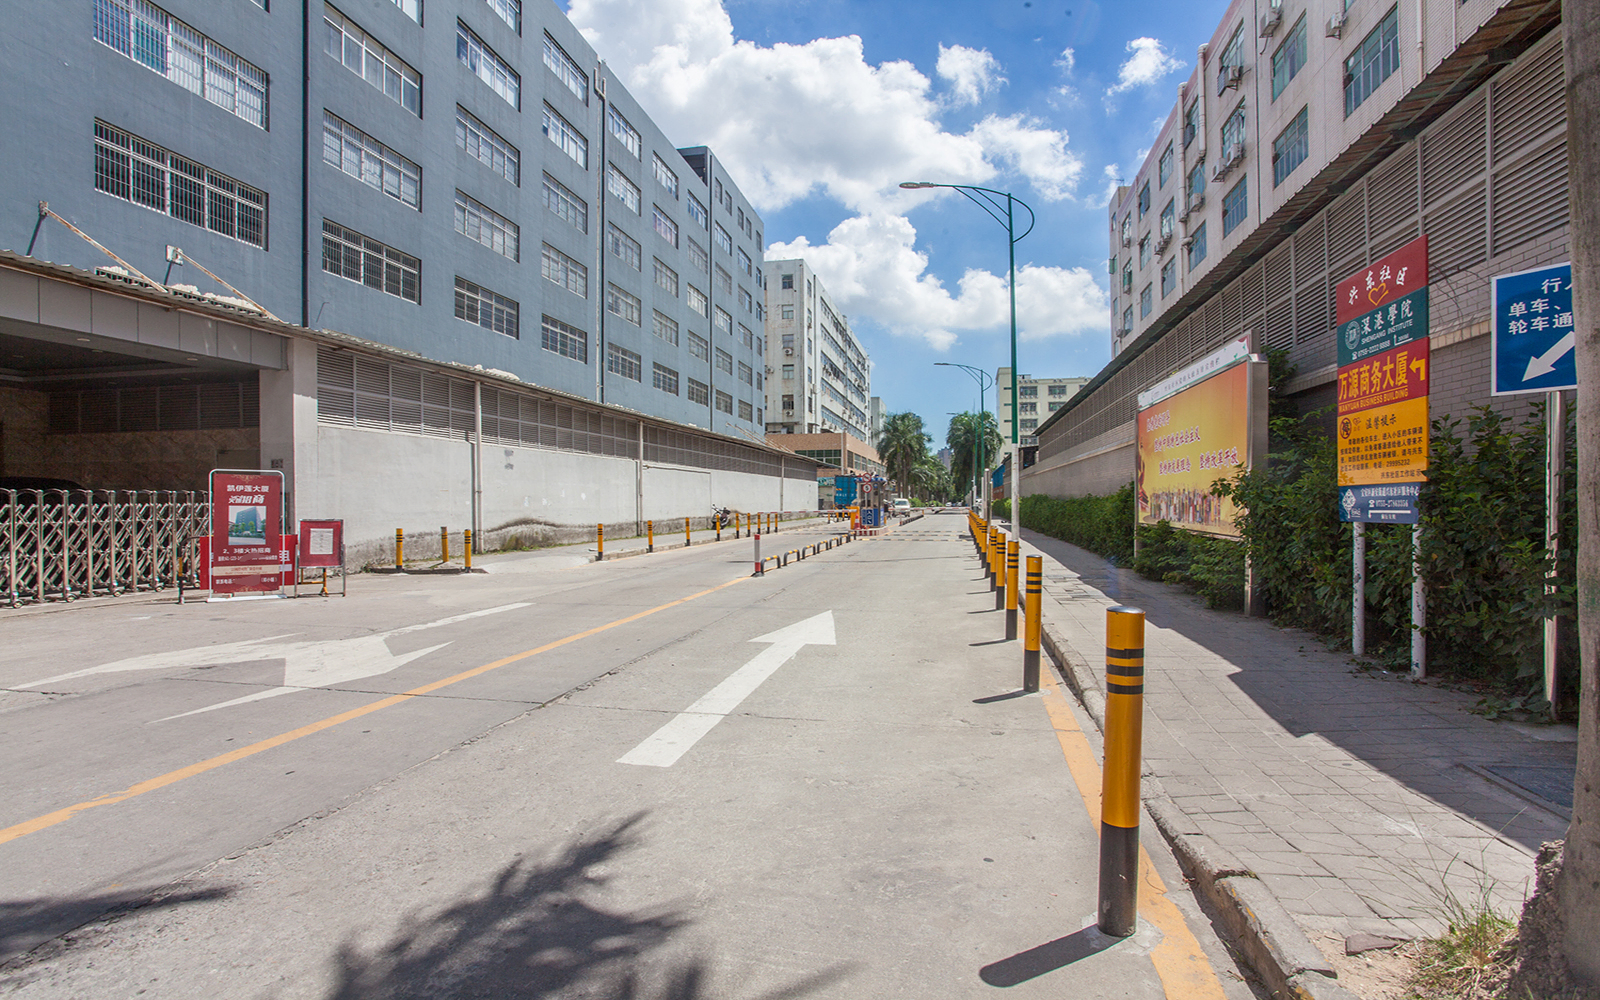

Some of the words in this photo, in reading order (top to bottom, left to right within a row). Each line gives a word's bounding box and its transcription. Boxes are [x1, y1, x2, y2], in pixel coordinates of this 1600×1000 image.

[1361, 329, 1387, 345] SHENGANG
[1387, 319, 1414, 335] INSTITUTE
[1508, 311, 1573, 335] 轮车通
[1338, 351, 1408, 401] 万源商务大厦
[1338, 400, 1360, 413] WANYUAN
[1360, 394, 1383, 409] BUSINESS
[1383, 388, 1408, 402] BUILDING
[1154, 425, 1201, 453] 坚持中国特色社会主义
[1199, 446, 1240, 470] 坚持改革开放
